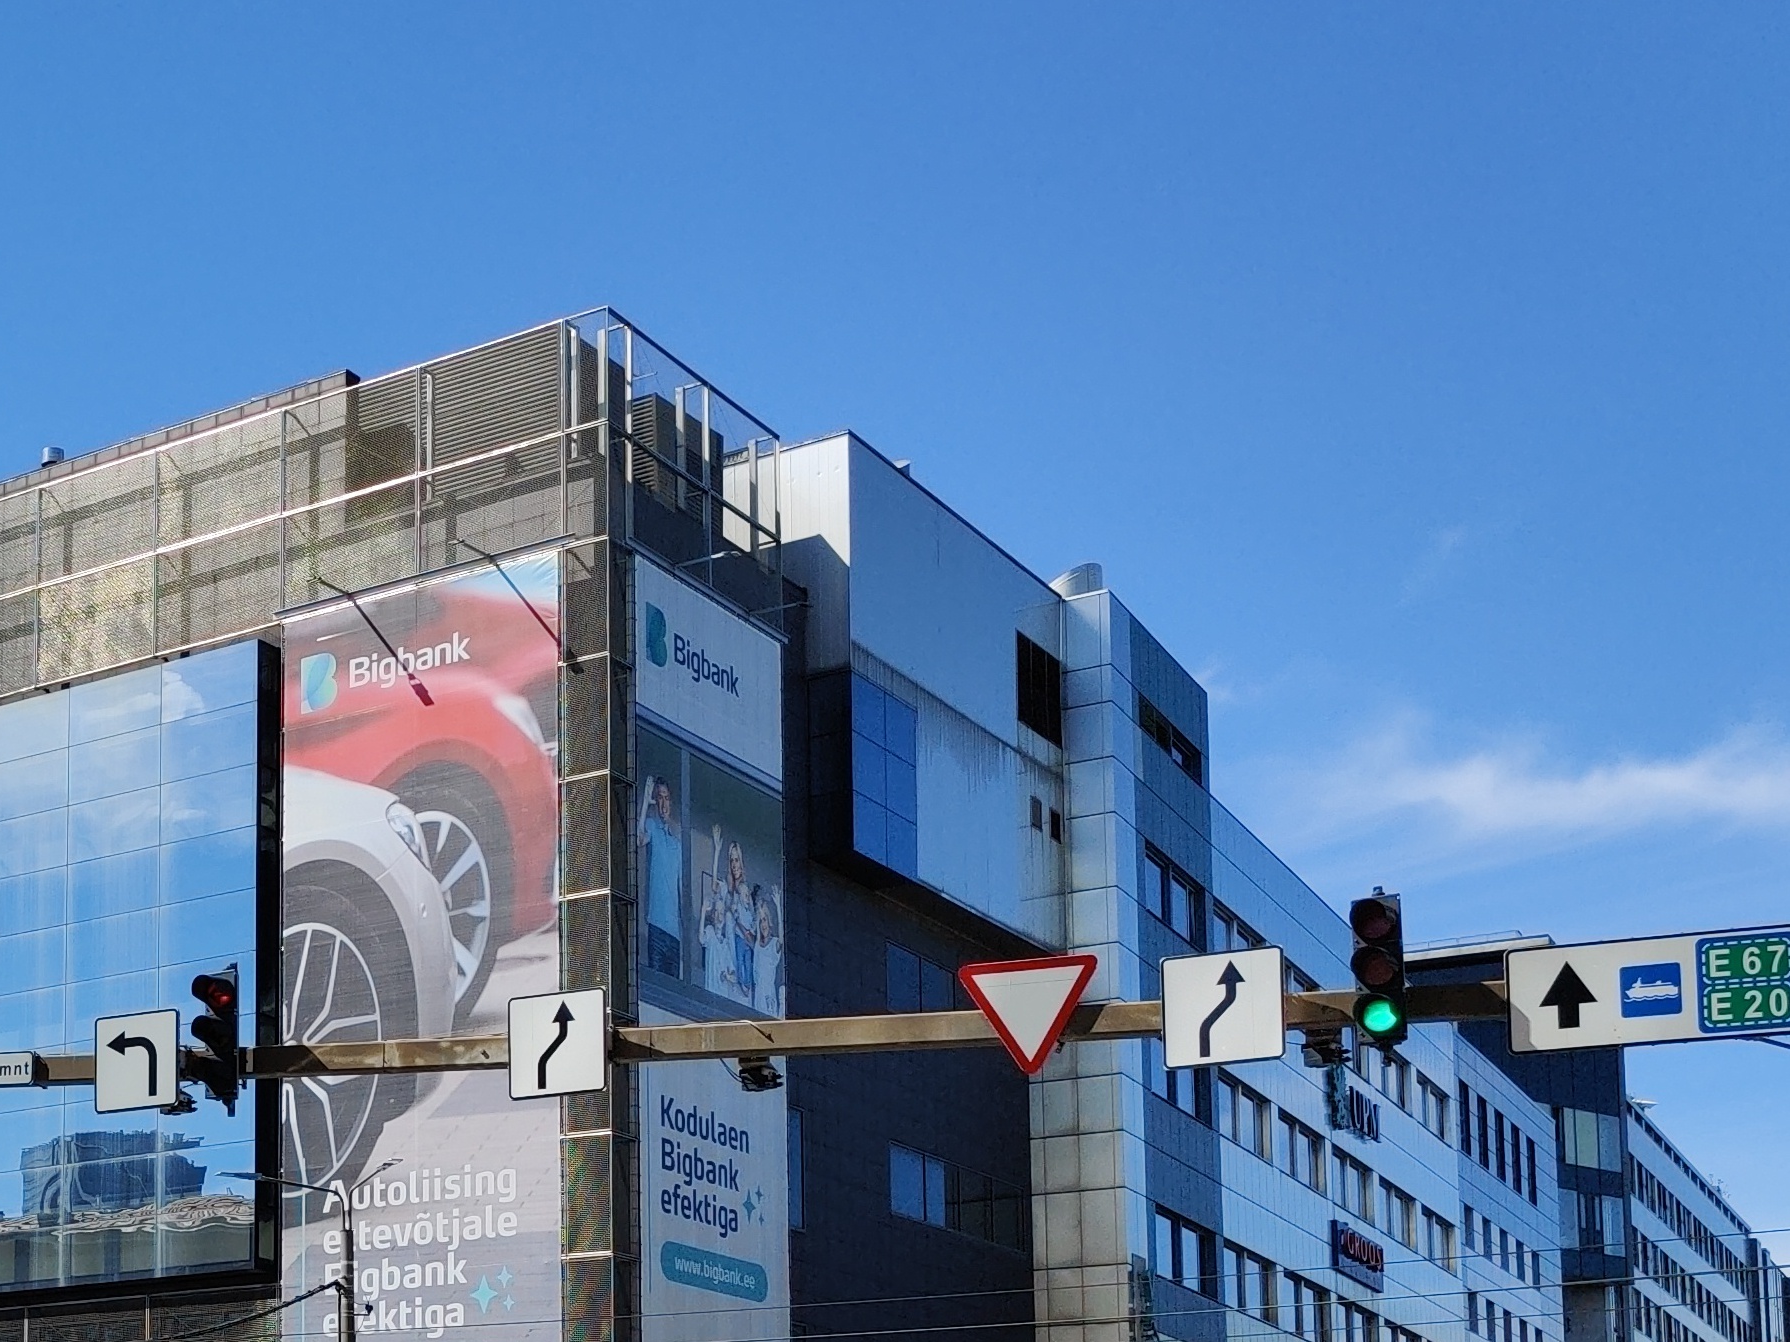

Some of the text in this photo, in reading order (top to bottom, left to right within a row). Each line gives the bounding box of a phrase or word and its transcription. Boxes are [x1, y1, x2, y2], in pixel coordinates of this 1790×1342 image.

[349, 631, 471, 689] Bigbank
[673, 632, 739, 698] Bigbank
[1709, 944, 1786, 977] E 67
[1711, 988, 1788, 1021] E 20
[0, 1061, 30, 1077] mnt
[660, 1094, 750, 1154] Kodulaen
[322, 1164, 517, 1214] Autoliising
[661, 1137, 740, 1192] Bigbank
[322, 1204, 518, 1254] etevõtjale
[660, 1184, 739, 1239] efektiga
[674, 1256, 756, 1290] www.bigbank.ee
[322, 1297, 465, 1339] eektiga
